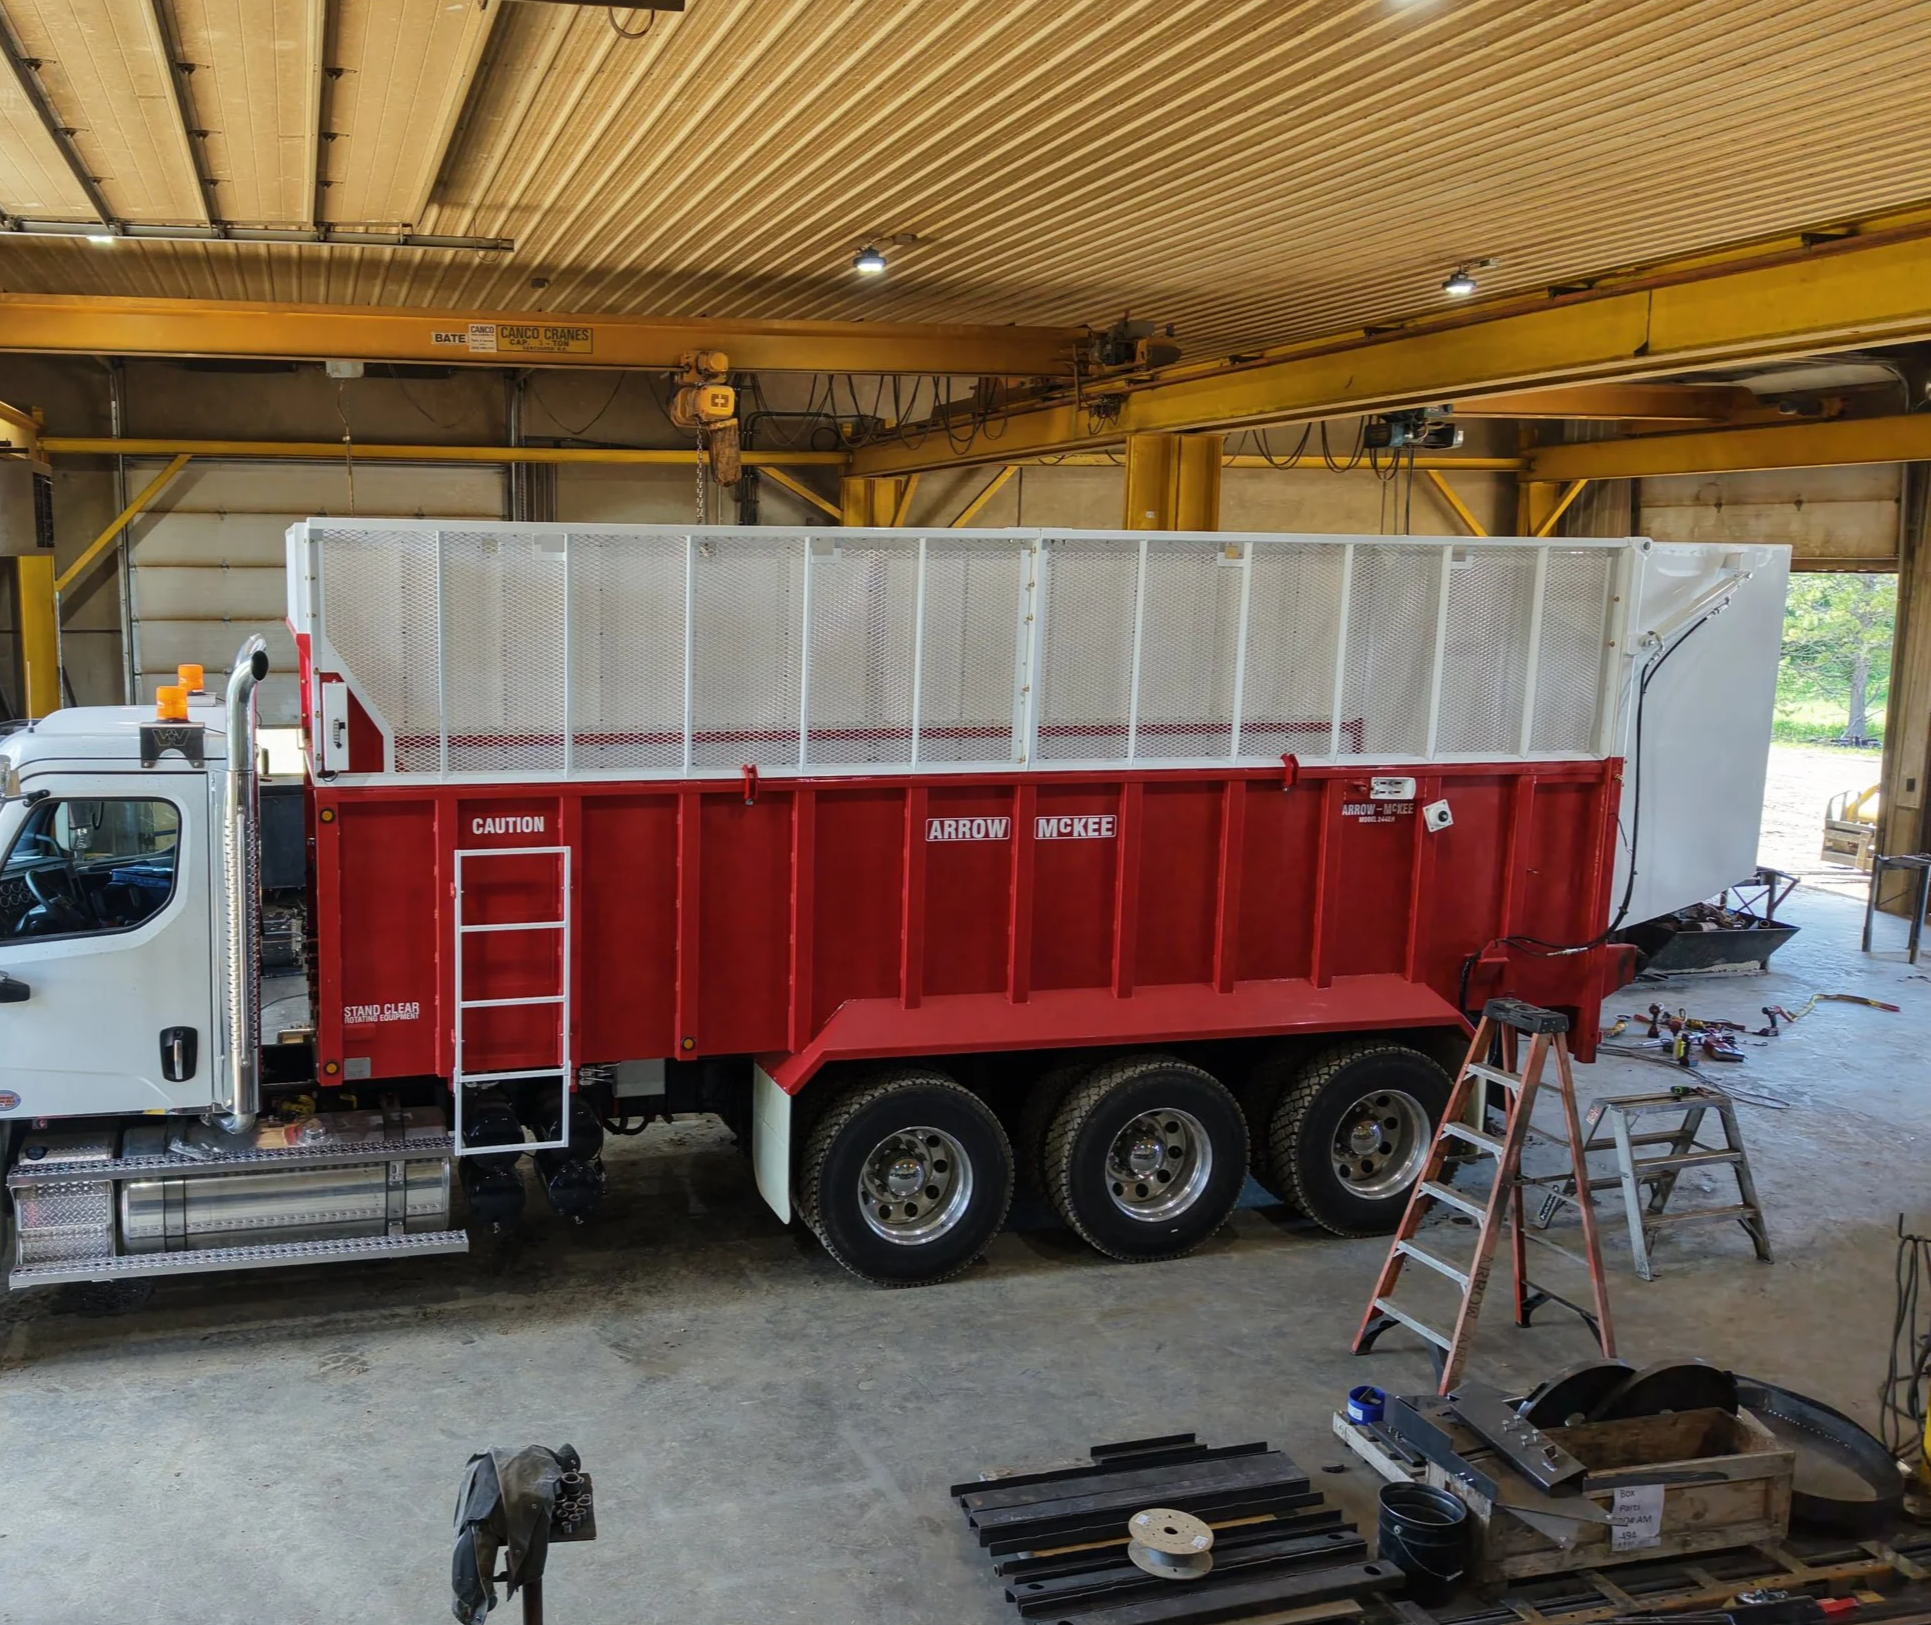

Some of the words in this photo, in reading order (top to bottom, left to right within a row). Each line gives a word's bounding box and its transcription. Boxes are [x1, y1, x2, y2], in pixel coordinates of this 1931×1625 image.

[470, 326, 495, 334] CANCO
[500, 326, 540, 339] CANCO
[544, 328, 589, 341] CRANES
[435, 334, 466, 343] BATE
[472, 816, 545, 835] CAUTION
[929, 819, 1007, 840] ARROW
[343, 1004, 381, 1017] STAND
[383, 1002, 420, 1015] CLEAR
[344, 1015, 378, 1024] ROTATING
[379, 1013, 420, 1022] EQUIPMENT
[1465, 1253, 1494, 1320] ARROW
[1620, 1489, 1636, 1498] Box
[1620, 1504, 1641, 1512] Parts
